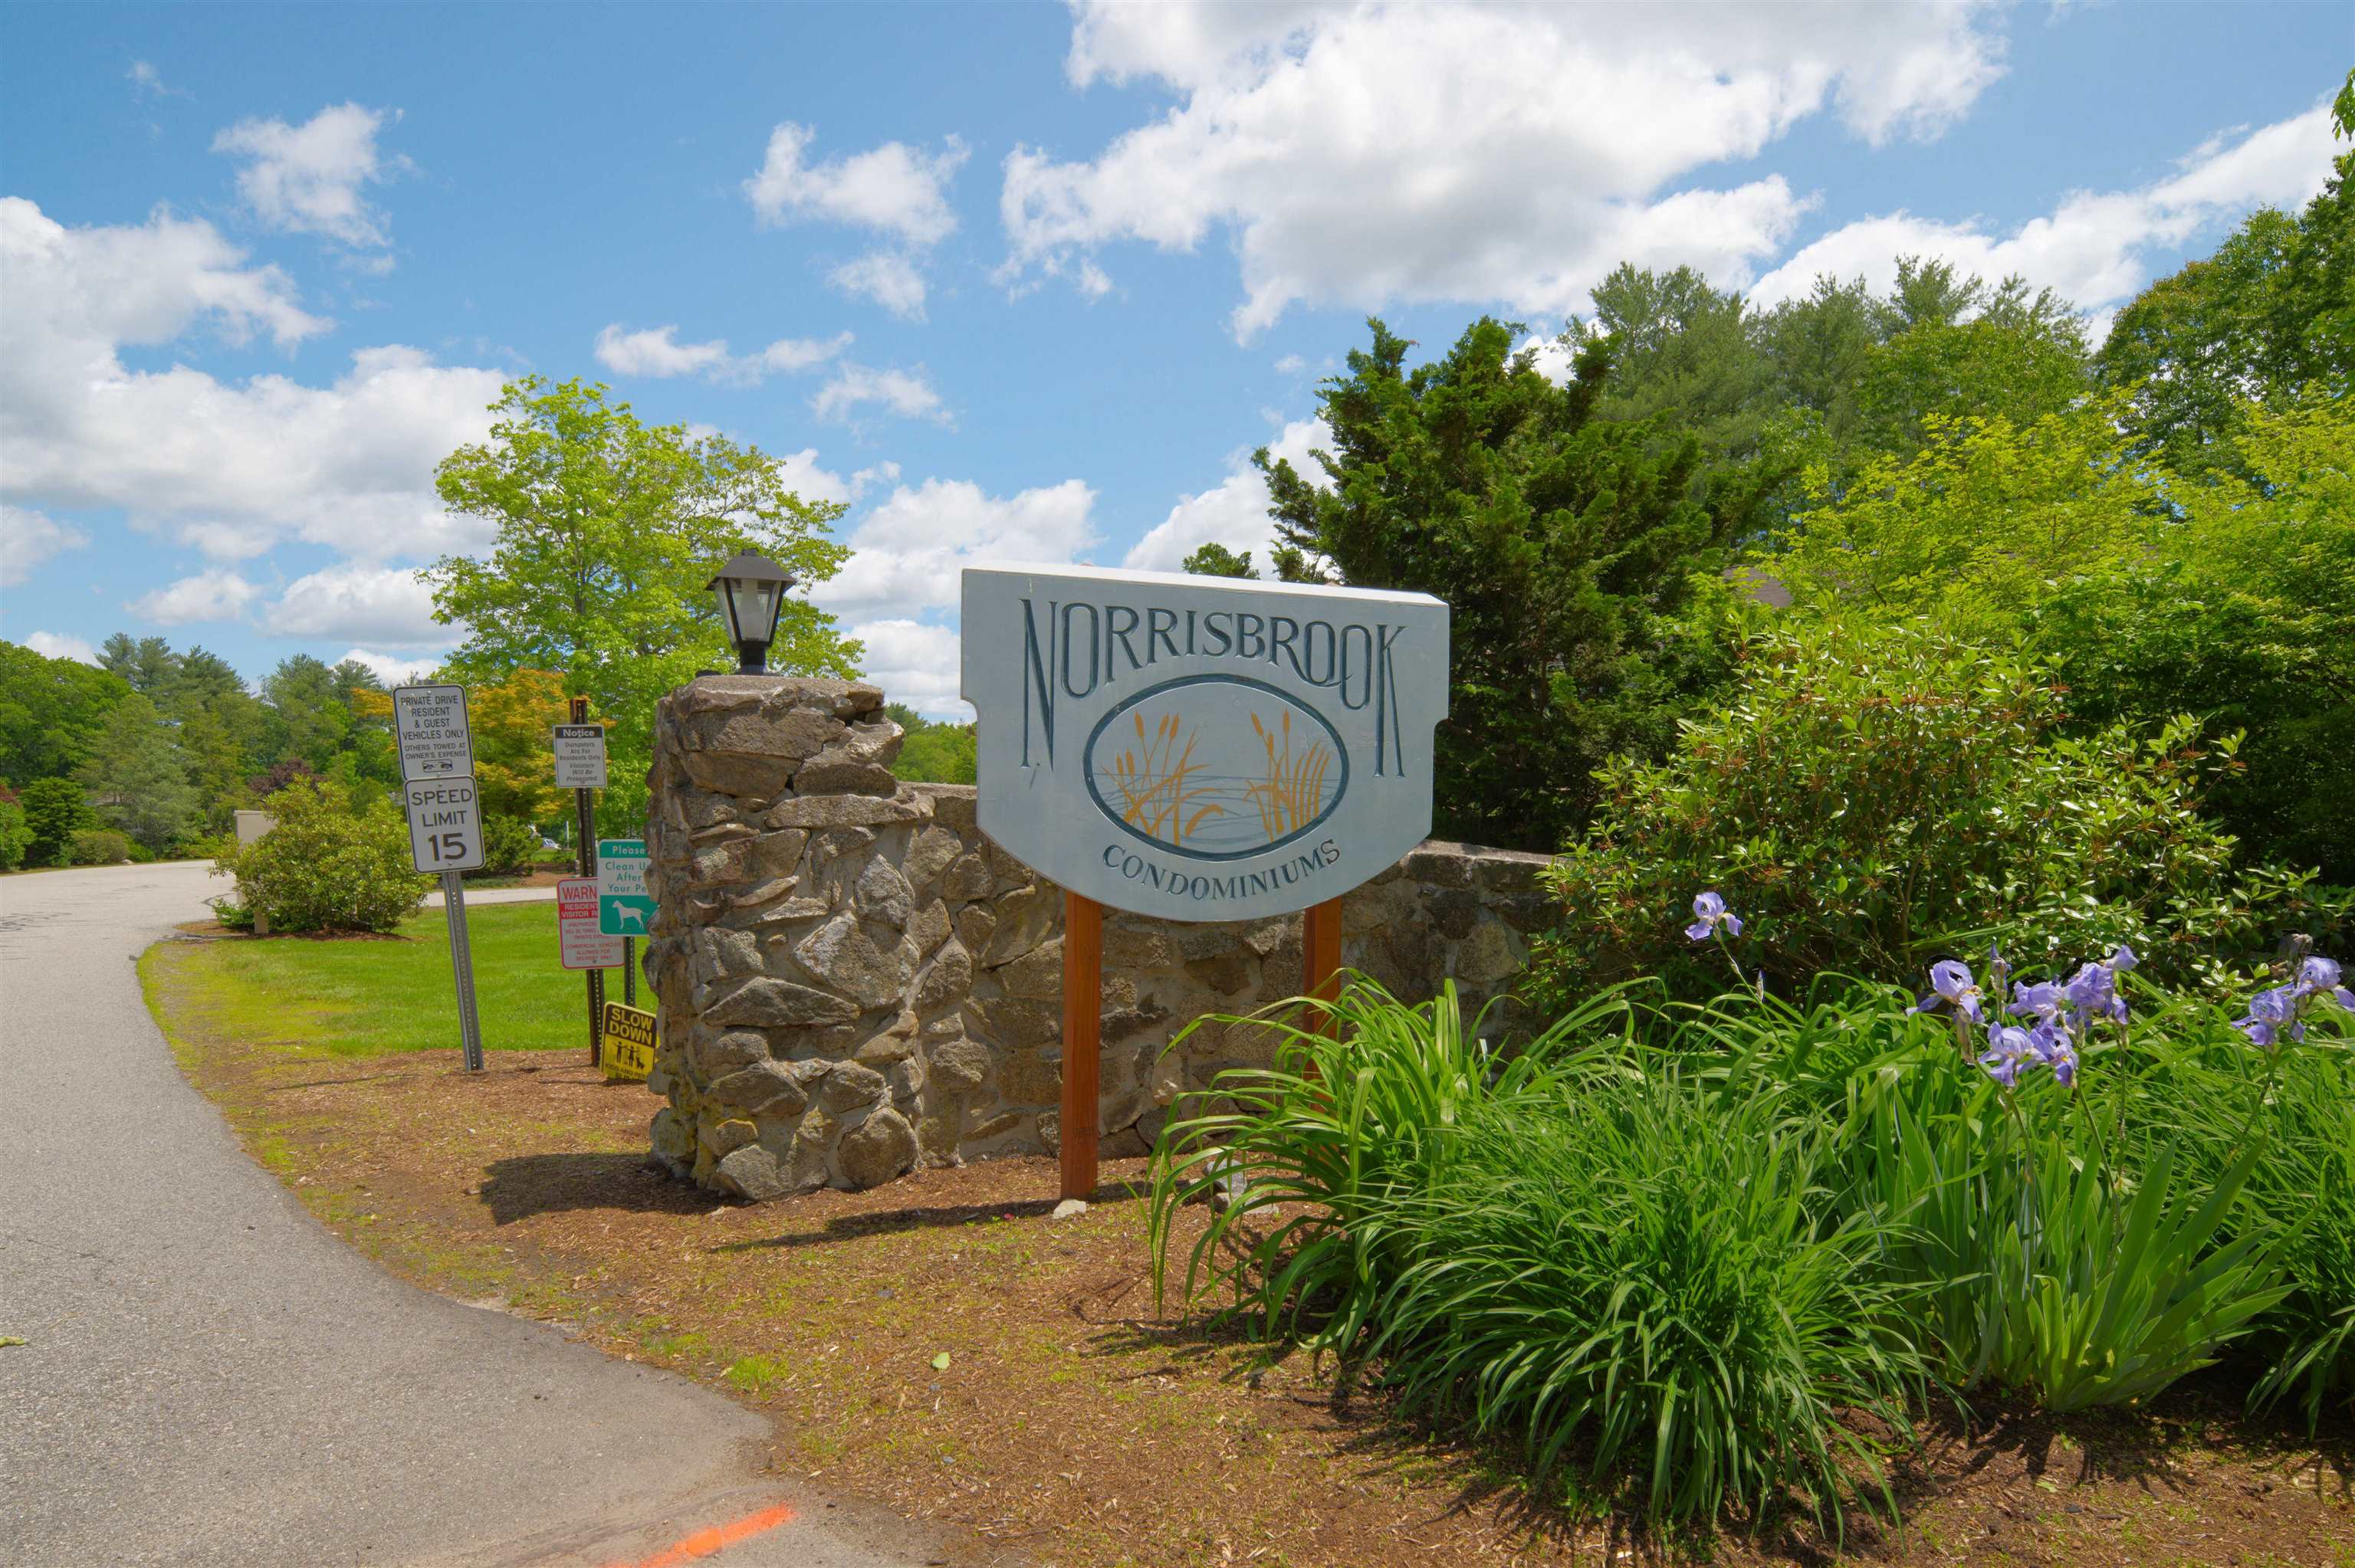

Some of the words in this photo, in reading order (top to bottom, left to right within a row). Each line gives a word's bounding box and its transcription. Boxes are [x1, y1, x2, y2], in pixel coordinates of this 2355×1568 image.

[1020, 598, 1407, 777] NORRISBROOK
[401, 696, 432, 705] PRIVATE
[435, 695, 458, 704] DRIVE
[412, 707, 450, 717] RESIDENT
[415, 720, 420, 728] &
[424, 718, 450, 728] GUEST
[402, 730, 442, 740] VEHICLES
[445, 729, 464, 738] ONLY
[412, 789, 472, 805] SPEED
[422, 810, 467, 827] LIMIT
[428, 832, 466, 861] 15
[613, 845, 645, 855] Please
[606, 861, 634, 871] Clean
[639, 861, 645, 871] U
[1102, 838, 1340, 900] CONDOMINIUMS
[616, 872, 642, 881] After
[562, 886, 597, 900] WARN
[608, 883, 630, 892] Your
[636, 884, 646, 893] Pe
[611, 1007, 652, 1031] SLOW
[609, 1020, 652, 1045] DOWN
